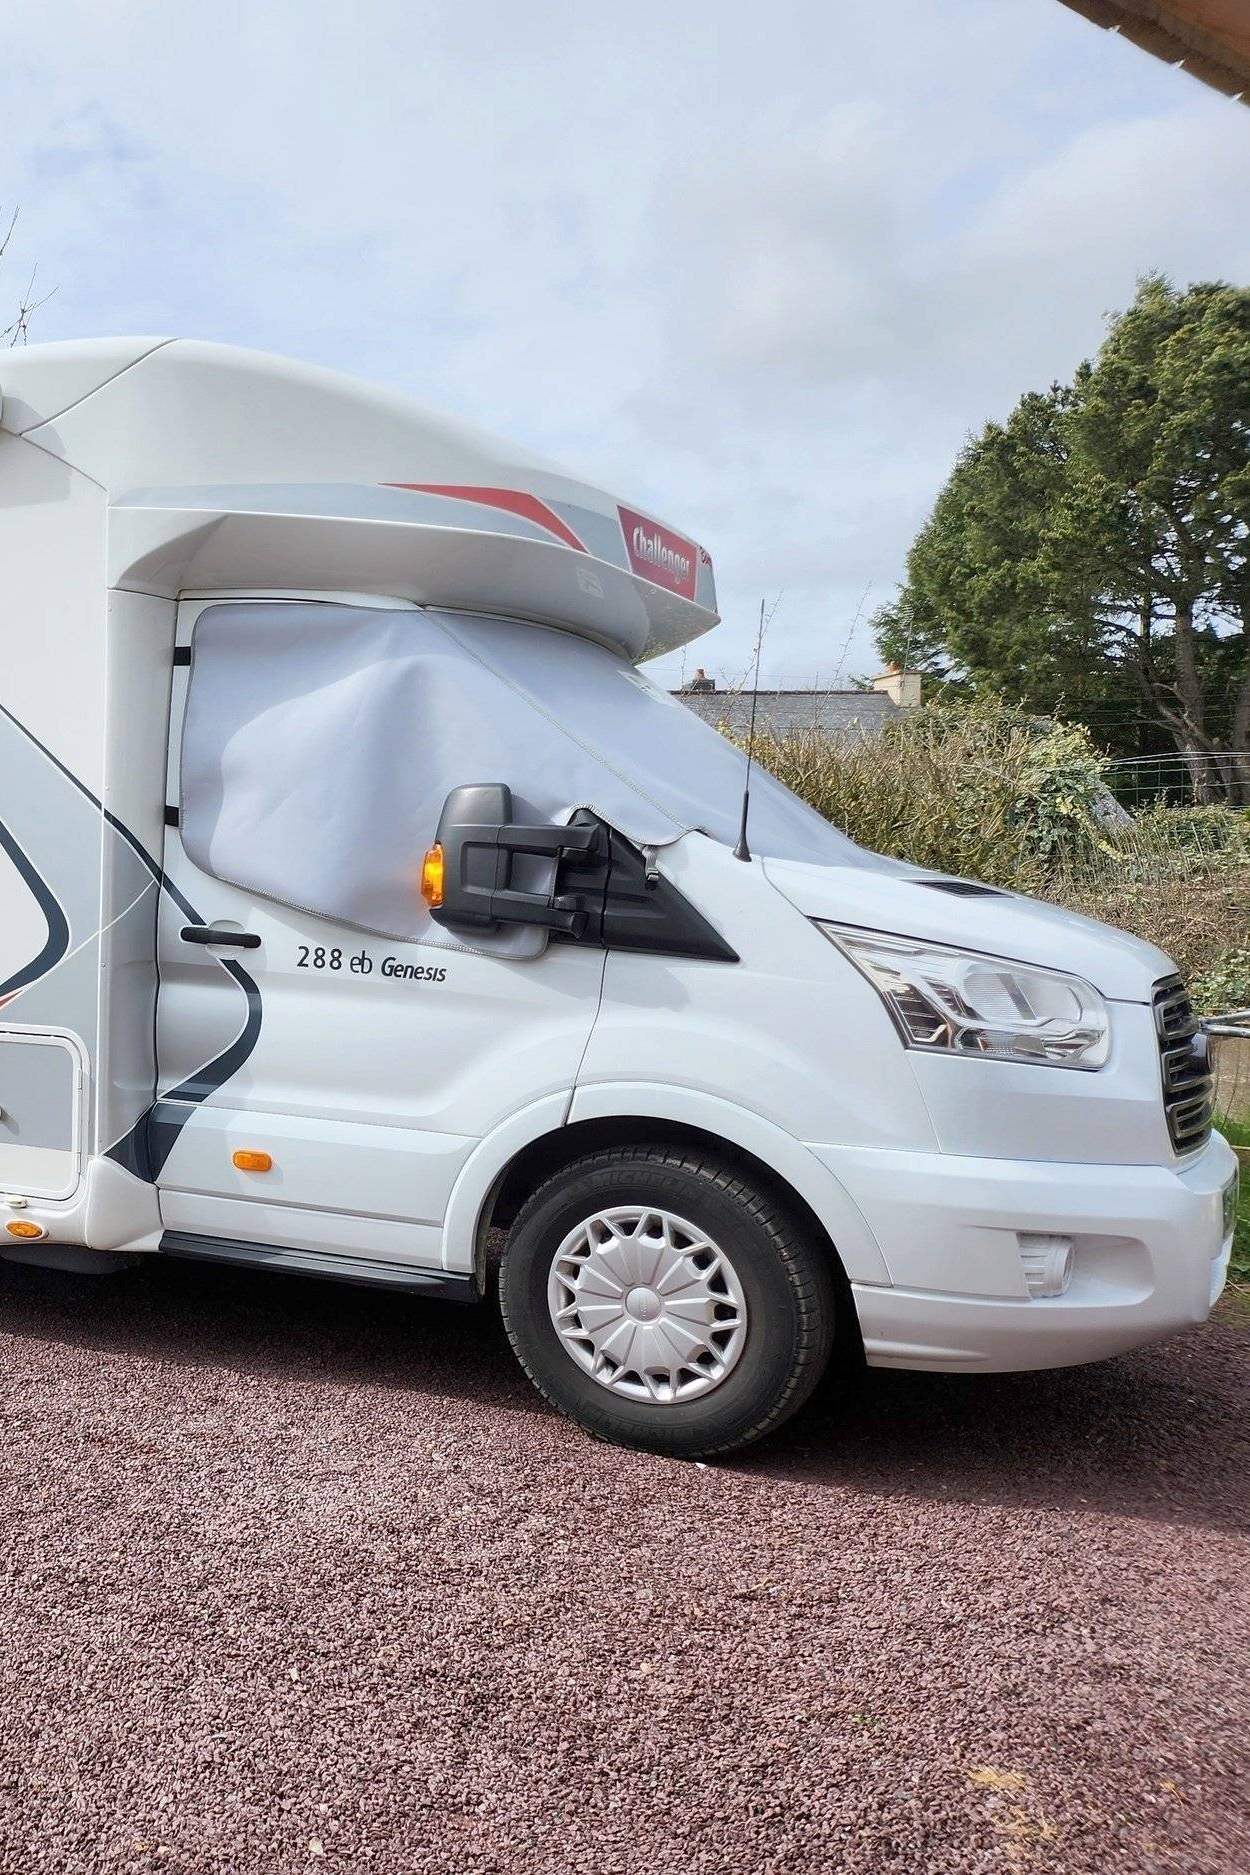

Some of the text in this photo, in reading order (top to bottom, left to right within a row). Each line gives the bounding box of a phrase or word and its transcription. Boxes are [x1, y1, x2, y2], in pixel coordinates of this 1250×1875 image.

[632, 526, 690, 585] Challenger
[297, 945, 447, 982] 288 eb Genesis
